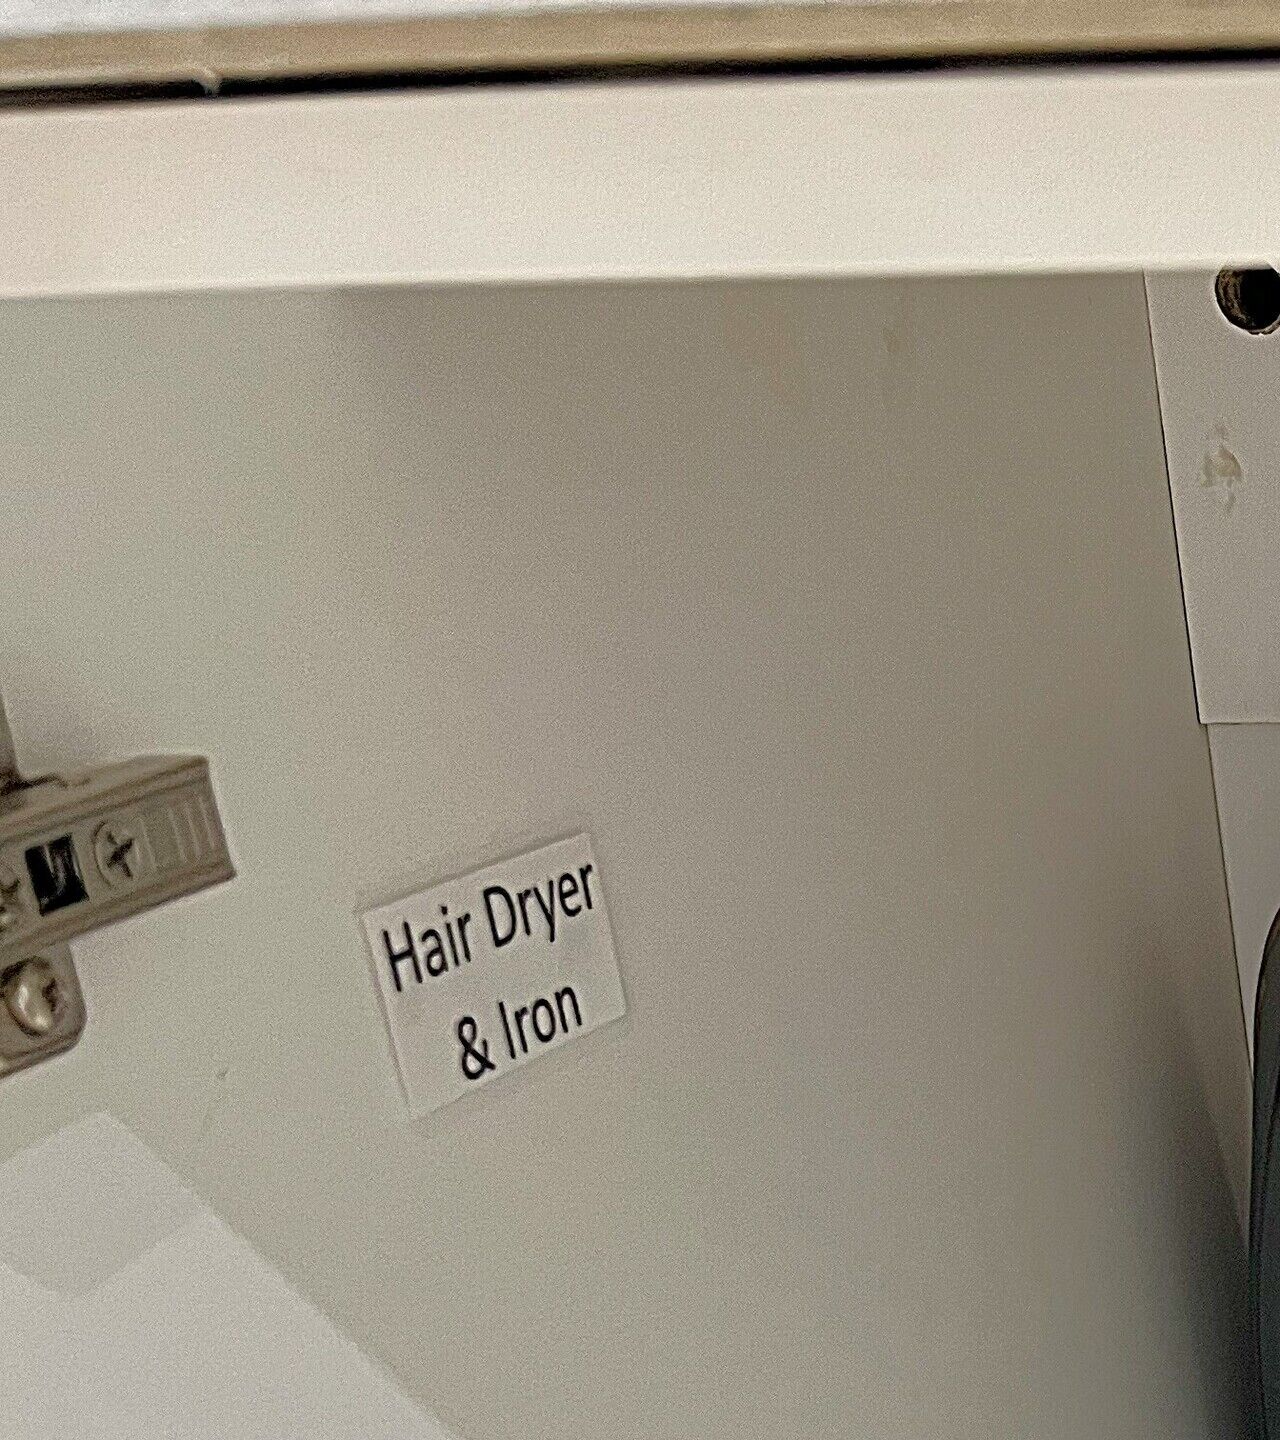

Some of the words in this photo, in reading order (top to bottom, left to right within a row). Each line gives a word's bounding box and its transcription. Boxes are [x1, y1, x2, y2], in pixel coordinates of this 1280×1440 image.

[382, 905, 472, 993] Hair
[483, 863, 594, 948] Dryer
[457, 1016, 496, 1080] &
[498, 986, 583, 1060] Iron
